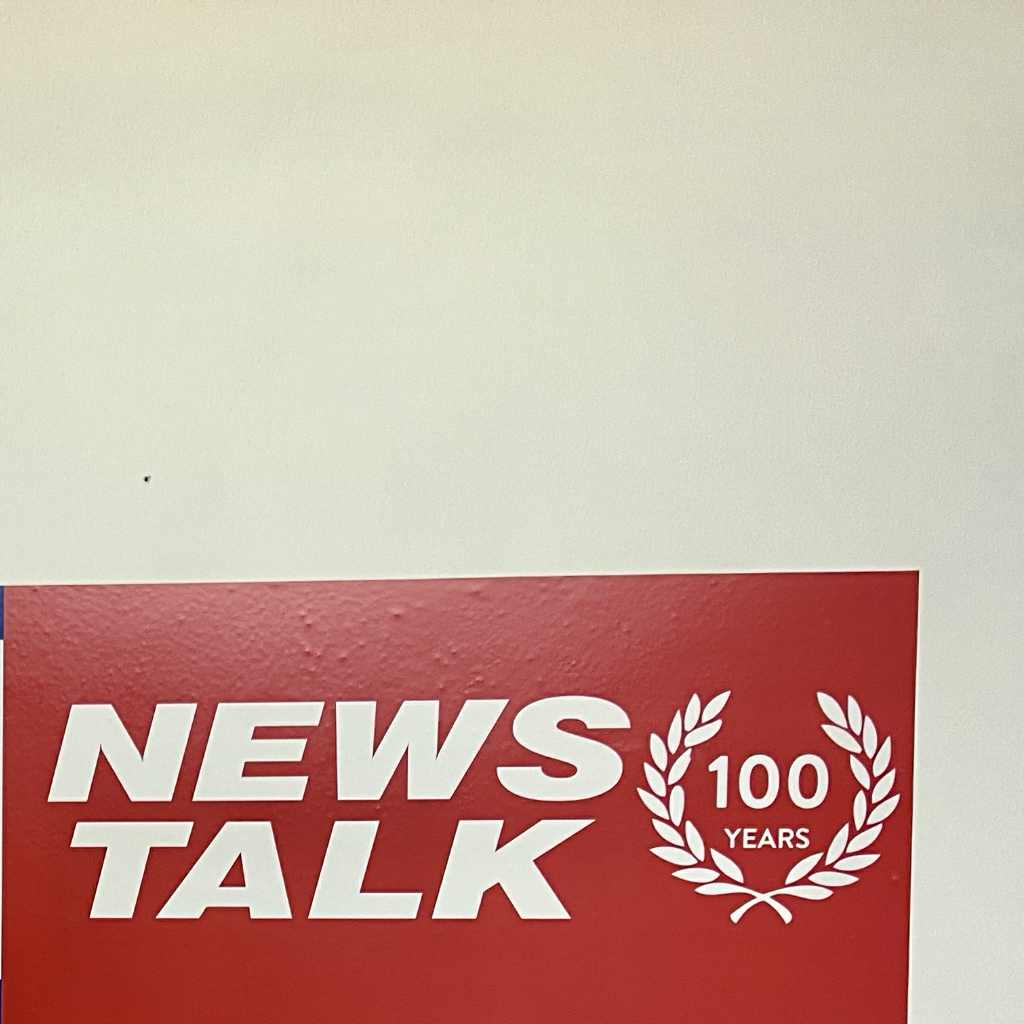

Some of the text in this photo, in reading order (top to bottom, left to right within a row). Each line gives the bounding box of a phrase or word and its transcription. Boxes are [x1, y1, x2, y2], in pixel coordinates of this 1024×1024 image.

[47, 695, 632, 804] NEWS
[708, 753, 829, 809] 100
[69, 818, 596, 920] TALK
[723, 827, 810, 849] YEARS
